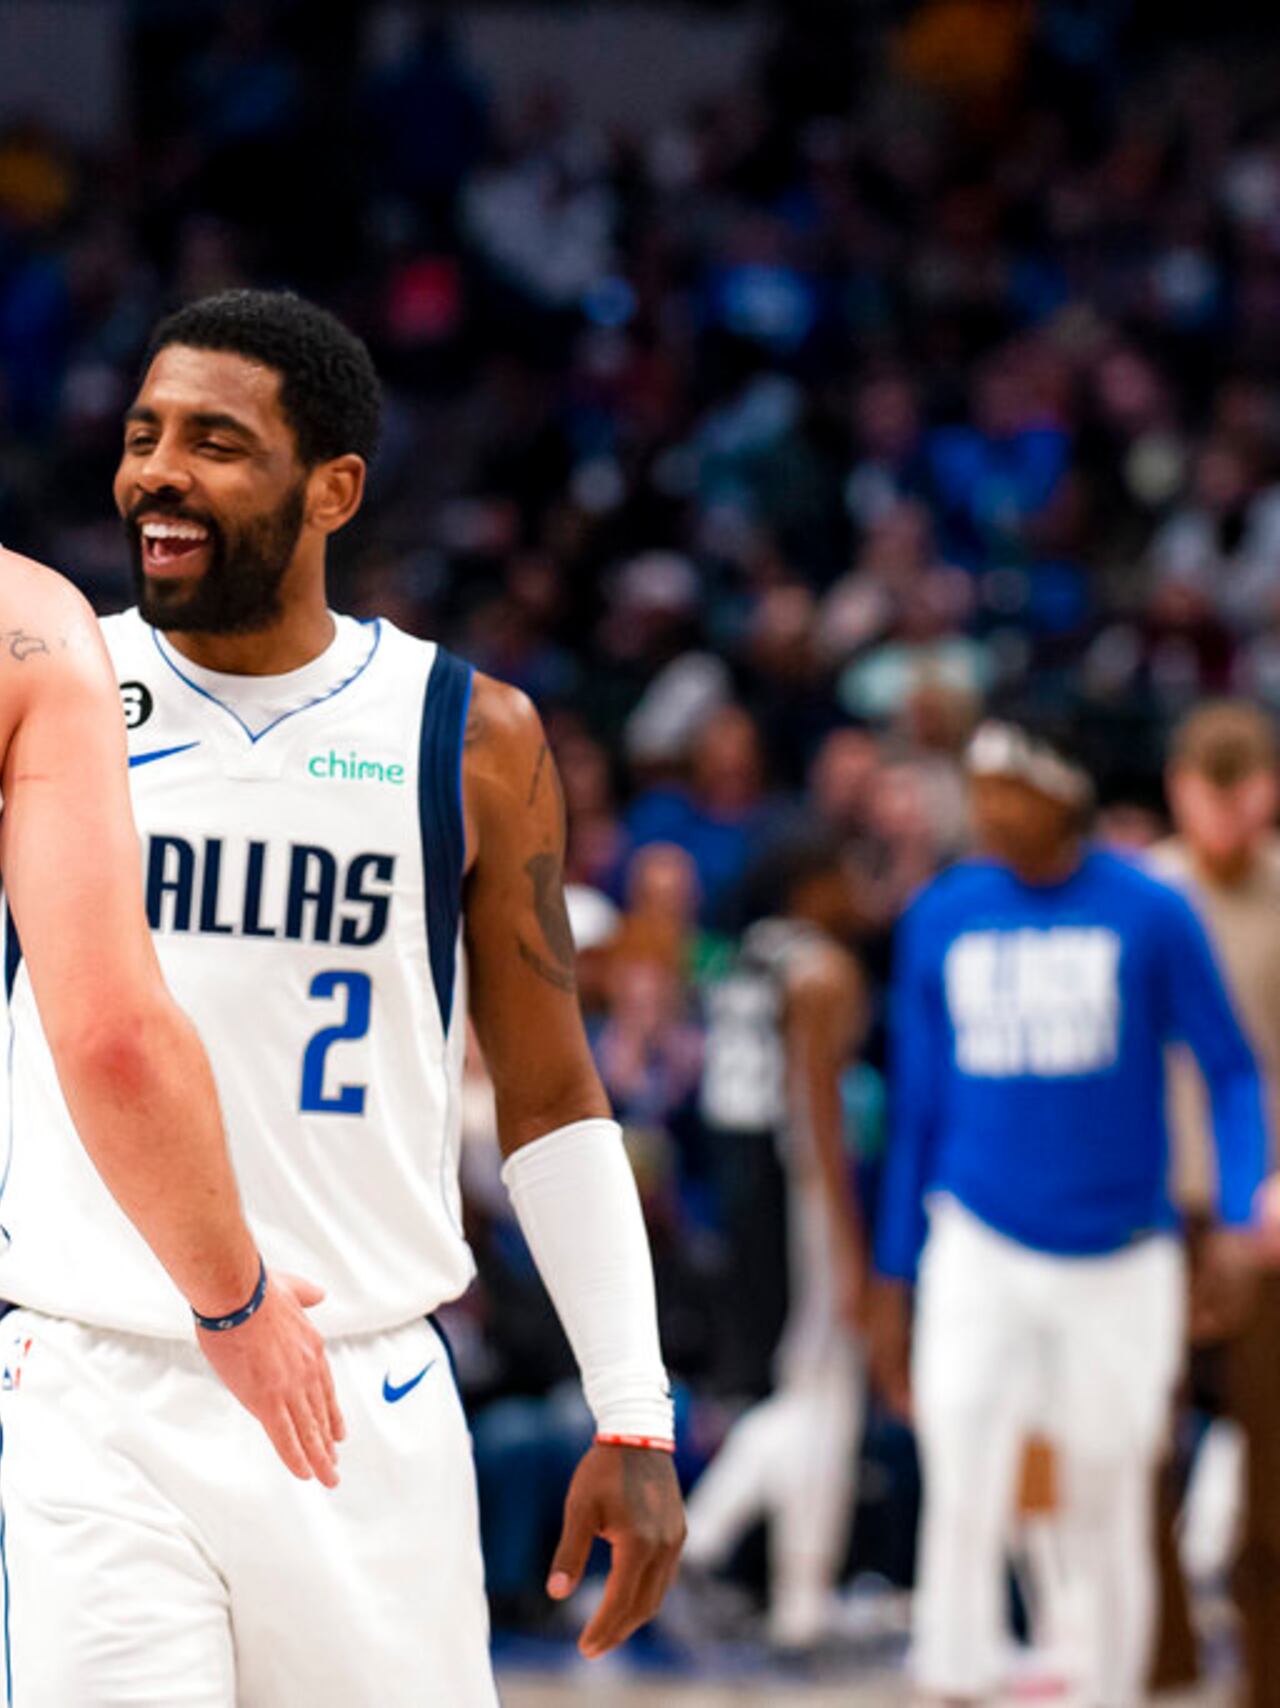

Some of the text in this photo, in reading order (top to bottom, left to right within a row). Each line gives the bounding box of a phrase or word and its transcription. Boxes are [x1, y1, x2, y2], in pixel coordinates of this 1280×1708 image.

[307, 750, 406, 785] chime
[144, 834, 396, 948] ALLAS
[298, 968, 374, 1118] 2
